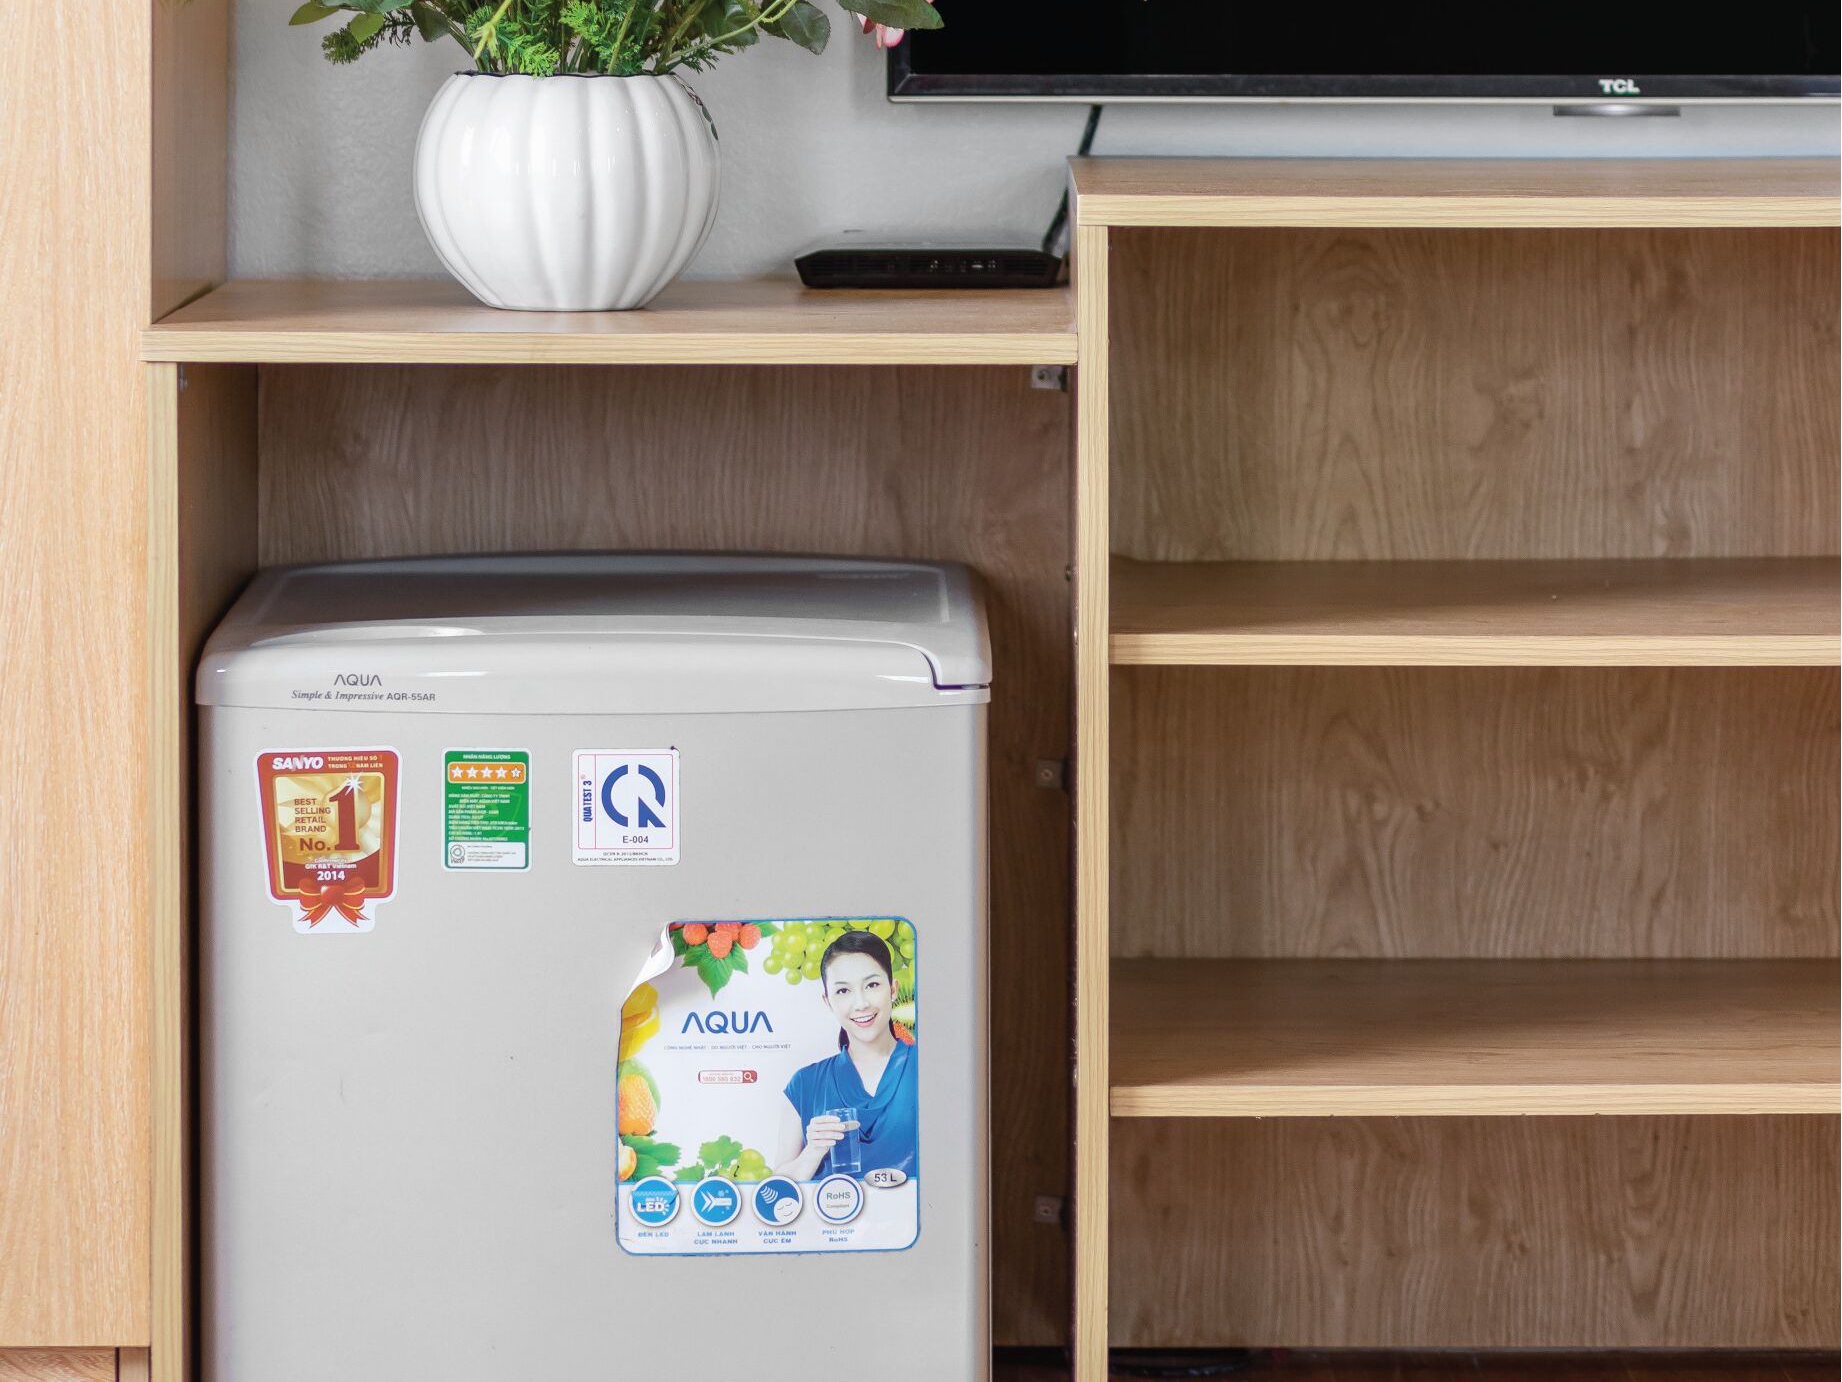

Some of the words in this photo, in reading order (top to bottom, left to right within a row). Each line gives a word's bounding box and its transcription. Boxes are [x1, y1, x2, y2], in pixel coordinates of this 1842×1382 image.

[1598, 78, 1640, 94] TCL
[334, 674, 382, 686] AQUA
[291, 690, 323, 701] Simple
[324, 692, 332, 700] &
[335, 691, 384, 702] Impressive
[386, 692, 436, 701] AQR-55AR
[272, 756, 324, 770] SANYO
[294, 798, 317, 806] BEST
[583, 788, 593, 822] QUATEST
[294, 807, 332, 815] SELLING
[294, 816, 327, 824] RETAIL
[295, 825, 327, 833] BRAND
[300, 838, 331, 851] No.
[622, 835, 649, 844] E-004
[317, 870, 346, 881] 2014
[681, 1010, 774, 1034] AQUA
[874, 1173, 888, 1182] 53
[890, 1173, 897, 1182] L
[826, 1191, 851, 1201] RoHS
[637, 1201, 665, 1213] LED
